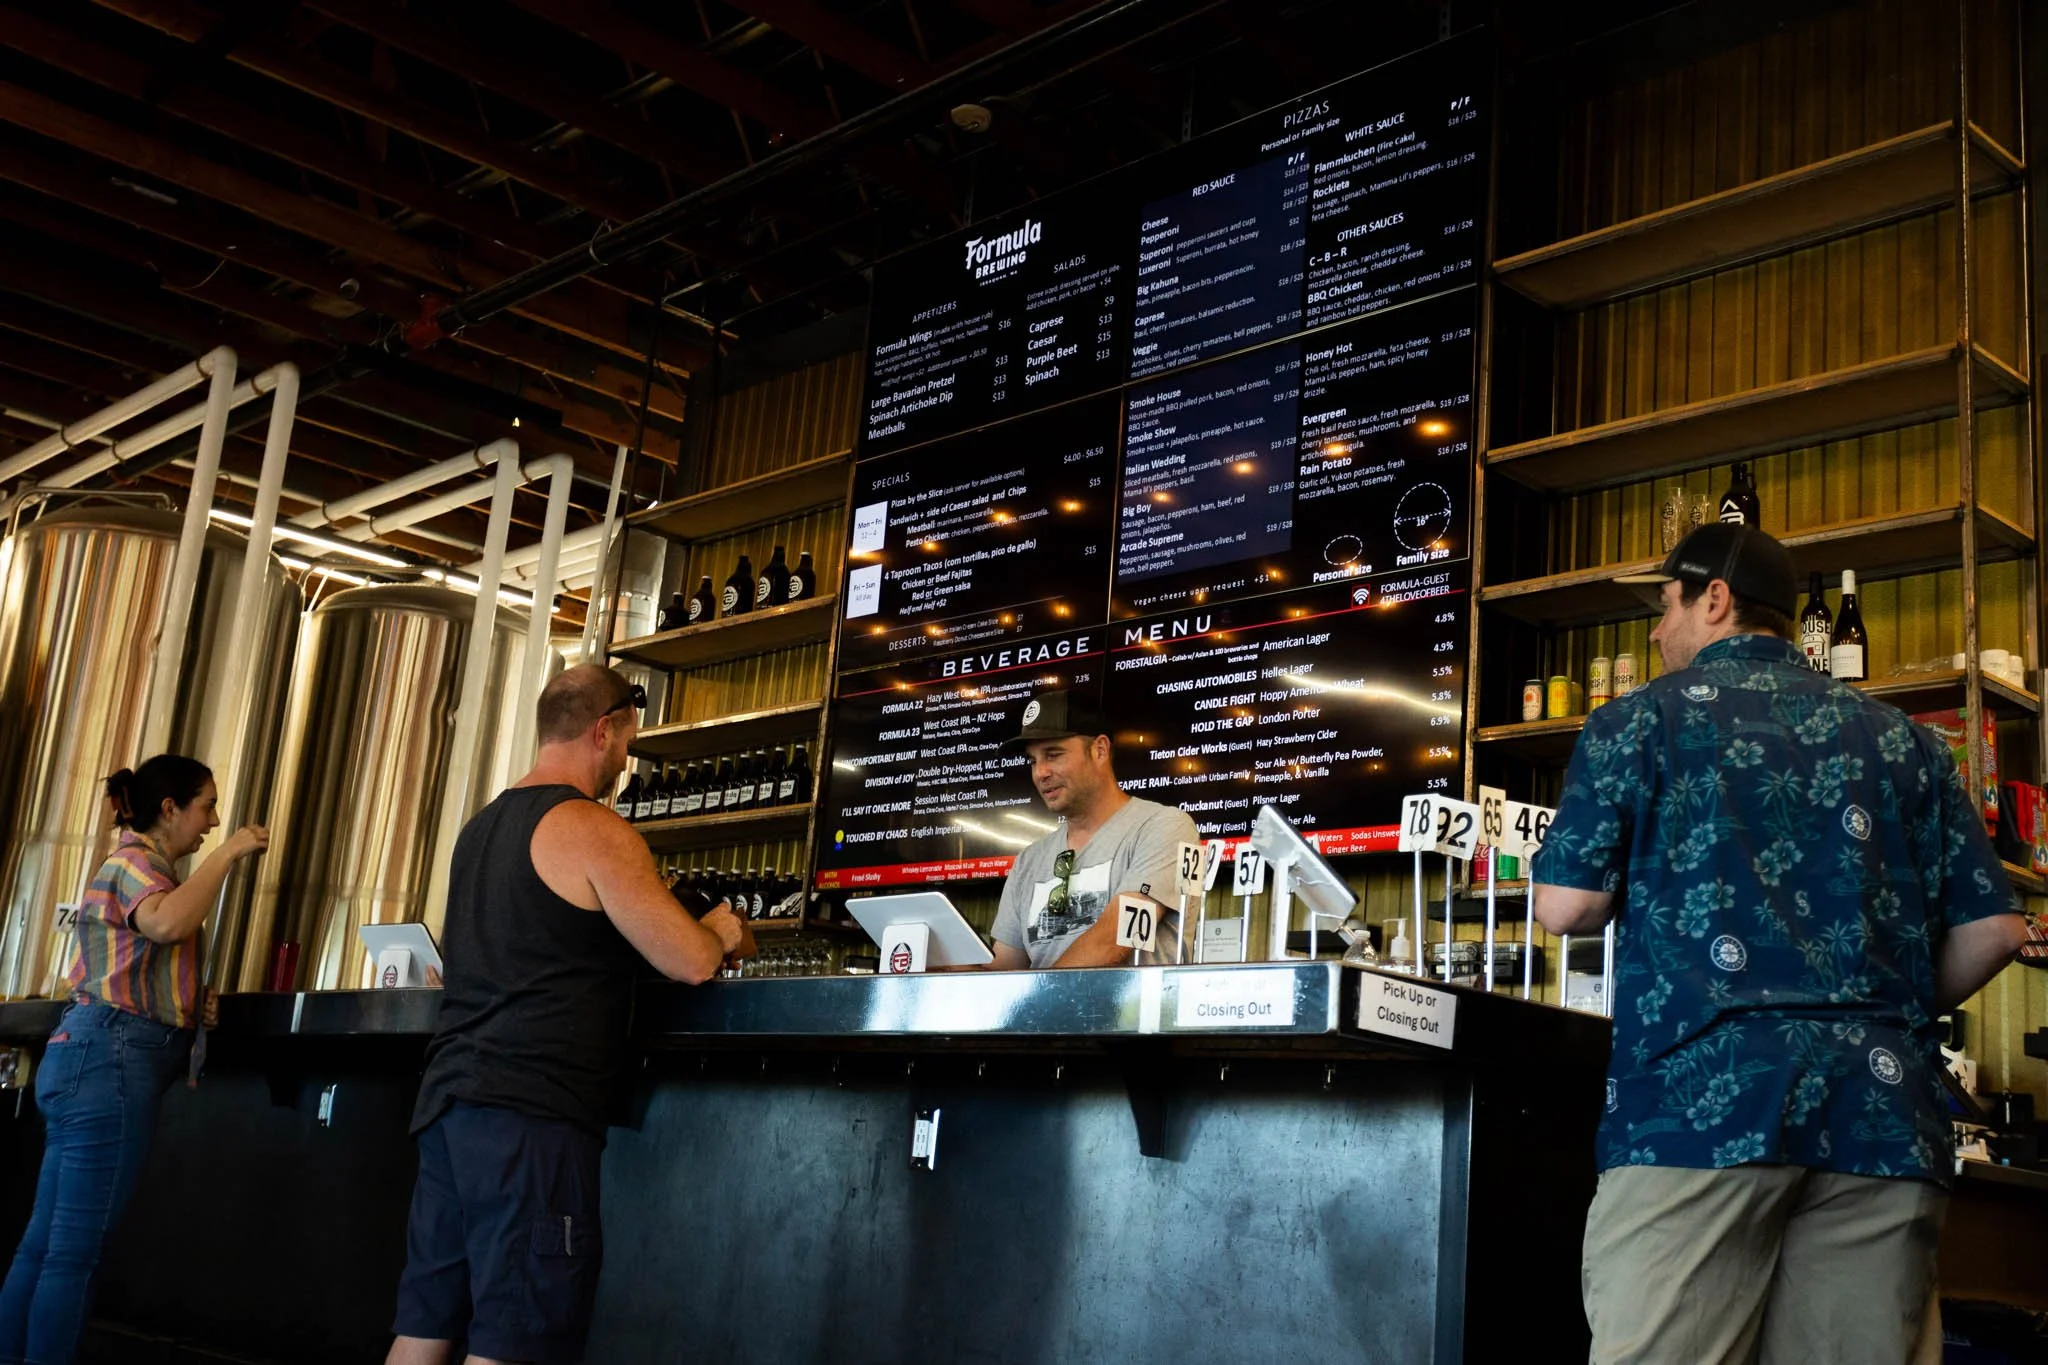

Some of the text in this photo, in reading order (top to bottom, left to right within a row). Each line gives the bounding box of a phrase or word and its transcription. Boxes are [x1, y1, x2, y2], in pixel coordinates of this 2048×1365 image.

[1283, 100, 1329, 128] PIZZAS
[1261, 117, 1340, 152] Personal or Family size
[1344, 112, 1404, 142] WHITE SAUCE
[1314, 131, 1415, 174] Flammkuchen (Fire Cake)
[1192, 173, 1235, 197] RED SAUCE
[1141, 216, 1169, 232] Cheese
[1337, 212, 1404, 242] OTHER SAUCES
[965, 219, 1041, 270] Formula
[1140, 224, 1179, 246] Pepperoni
[1139, 243, 1173, 262] Superoni
[975, 250, 1026, 279] BREWING
[1053, 254, 1086, 273] SALADS
[1138, 257, 1171, 276] Luxeroni
[1137, 275, 1179, 296] Big Kahuna
[1307, 280, 1363, 304] BBQ Chicken
[1104, 295, 1114, 307] $9
[912, 300, 957, 323] APPETIZERS
[1098, 313, 1113, 326] $13
[1134, 311, 1165, 327] Caprese
[998, 318, 1011, 330] $16
[1029, 315, 1064, 333] Caprese
[876, 338, 907, 356] Formula
[909, 330, 932, 344] Wings
[1027, 334, 1057, 350] Caesar
[1097, 330, 1111, 343] $15
[1026, 343, 1078, 368] Purple Beet
[1096, 348, 1110, 361] $13
[1132, 342, 1158, 356] Veggie
[1305, 342, 1353, 363] Honey Hot
[995, 354, 1008, 367] $13
[993, 373, 1007, 386] $13
[1024, 365, 1059, 386] Spinach
[871, 396, 891, 409] Large
[892, 385, 926, 402] Bavarian
[927, 373, 955, 391] Pretzel
[992, 390, 1005, 402] $13
[1129, 389, 1181, 410] Smoke House
[869, 390, 953, 425] Spinach Artichoke Dip
[1302, 408, 1347, 426] Evergreen
[868, 420, 906, 440] Meatballs
[1127, 425, 1176, 445] Smoke Show
[1125, 453, 1186, 476] Italian Wedding
[1300, 457, 1352, 476] Rain Potato
[871, 471, 910, 490] SPECIALS
[1089, 476, 1101, 488] $15
[889, 511, 919, 527] Sandwich
[926, 506, 940, 517] side
[940, 503, 949, 514] of
[948, 500, 971, 512] Caesar
[971, 493, 989, 506] salad
[991, 489, 1005, 501] and
[1007, 486, 1027, 497] Chips
[890, 489, 943, 508] Pizza by the Slice
[1122, 503, 1152, 517] Big Boy
[1084, 545, 1097, 556] $15
[1119, 532, 1184, 553] Arcade Supreme
[1396, 545, 1450, 566] Family size
[1380, 572, 1450, 594] FORMULA-GUEST
[1378, 583, 1450, 605] 4THELOVEOFBEER
[1434, 611, 1455, 623] 4.8%
[1124, 614, 1211, 645] MENU
[1801, 620, 1830, 634] OUSE
[888, 635, 926, 651] DESSERTS
[1262, 632, 1330, 651] American Lager
[1433, 640, 1454, 652] 4.9%
[942, 636, 1090, 677] BEVERAGE
[1115, 653, 1168, 671] FORESTALGIA
[1075, 673, 1090, 683] 7.3%
[1432, 665, 1452, 677] 5.5%
[1156, 669, 1257, 694] CHASING AUTOMOBILES
[1194, 692, 1256, 711] CANDLE FIGHT
[1430, 688, 1452, 702] 5.8%
[881, 701, 914, 714] FORMULA
[914, 699, 923, 709] 22
[1257, 706, 1321, 726] London Porter
[1190, 715, 1254, 733] HOLD THE GAP
[1429, 713, 1451, 727] 6.9%
[878, 728, 911, 741] FORMULA
[911, 726, 920, 736] 23
[894, 749, 917, 762] BLUNT
[1149, 739, 1253, 760] Tieton Cider Works (Guest)
[1428, 744, 1449, 758] 5.5%
[864, 775, 894, 788] DIVISION
[894, 774, 902, 784] of
[901, 773, 915, 783] JOY
[1427, 777, 1448, 789] 5.5%
[841, 807, 852, 817] I'LL
[852, 806, 865, 816] SAY
[864, 805, 872, 814] IT
[871, 803, 890, 814] ONCE
[890, 800, 911, 812] MORE
[1178, 795, 1249, 814] Chuckanut (Guest)
[1409, 798, 1431, 837] 78
[1483, 796, 1502, 838] 65
[1514, 806, 1550, 845] 46
[845, 828, 908, 843] TOUCHED BY CHAOS
[1436, 806, 1473, 849] 92
[1182, 846, 1200, 881] 52
[1239, 850, 1260, 886] 57
[58, 908, 79, 929] 74
[1125, 905, 1152, 943] 70
[1383, 981, 1437, 1008] Pick Up or
[1197, 1001, 1272, 1019] Closing Out
[1377, 1006, 1440, 1034] Closing Out
